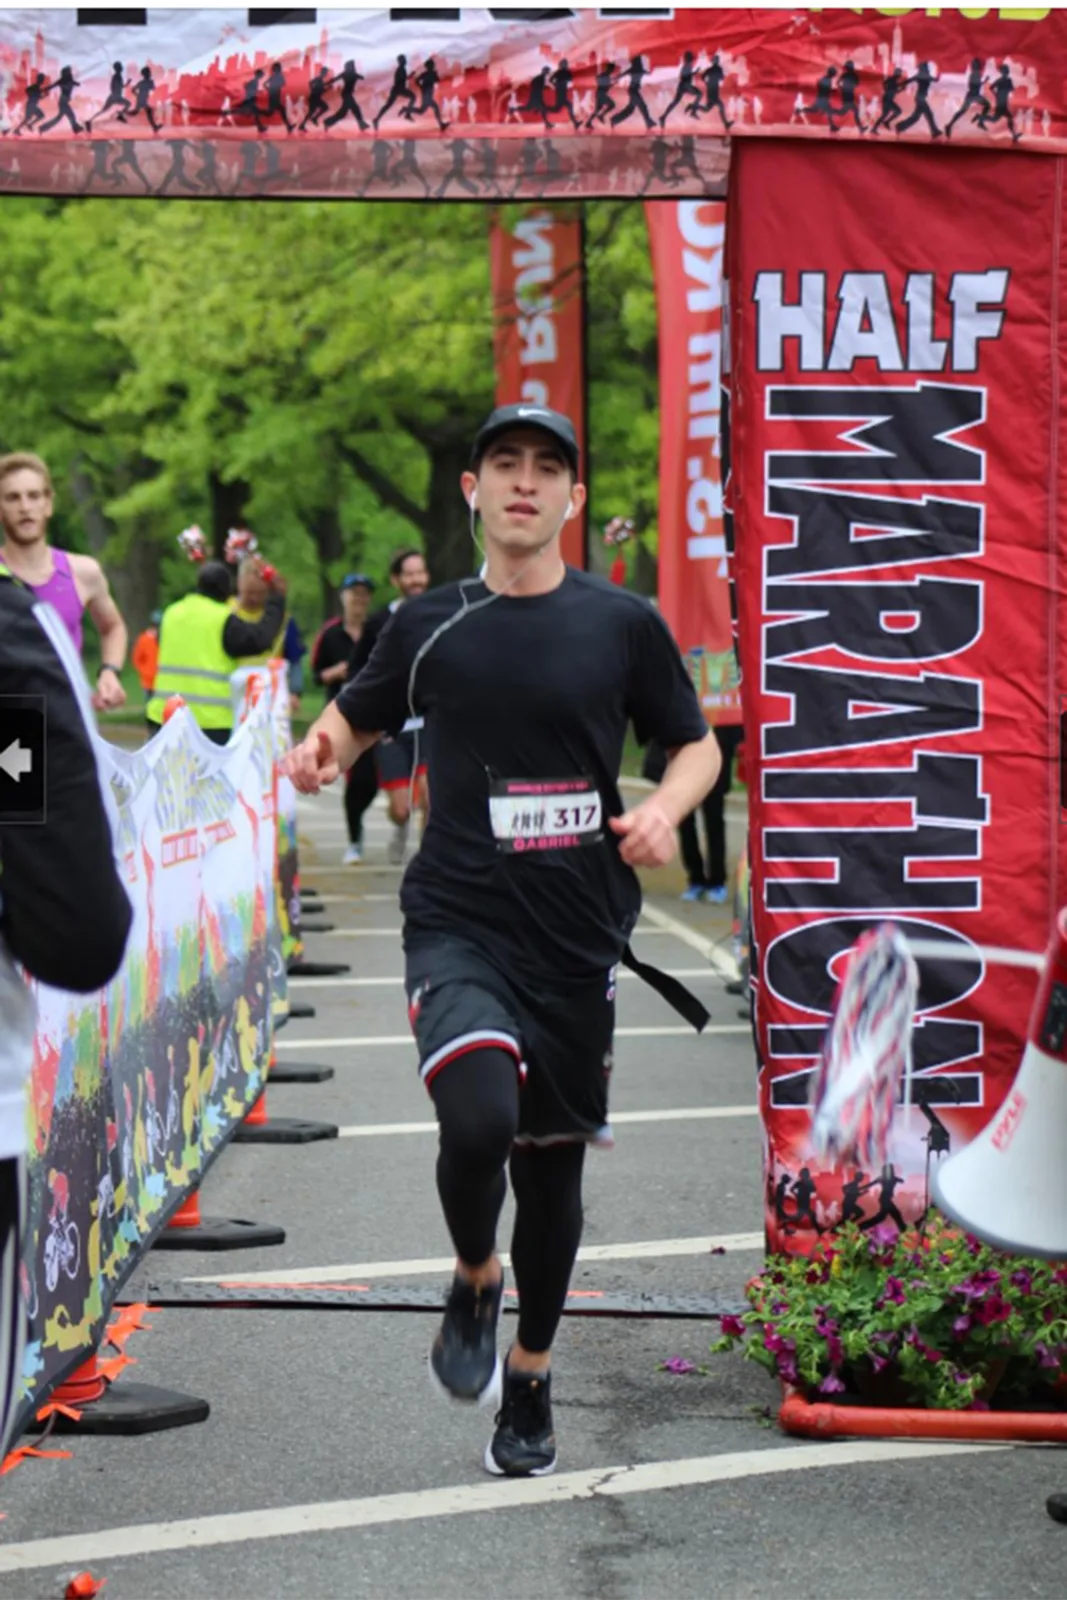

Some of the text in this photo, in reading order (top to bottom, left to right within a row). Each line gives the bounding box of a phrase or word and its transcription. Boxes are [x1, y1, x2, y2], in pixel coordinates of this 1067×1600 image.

[753, 268, 1011, 372] HALF
[761, 379, 990, 1109] MARATHON
[554, 804, 597, 828] 317
